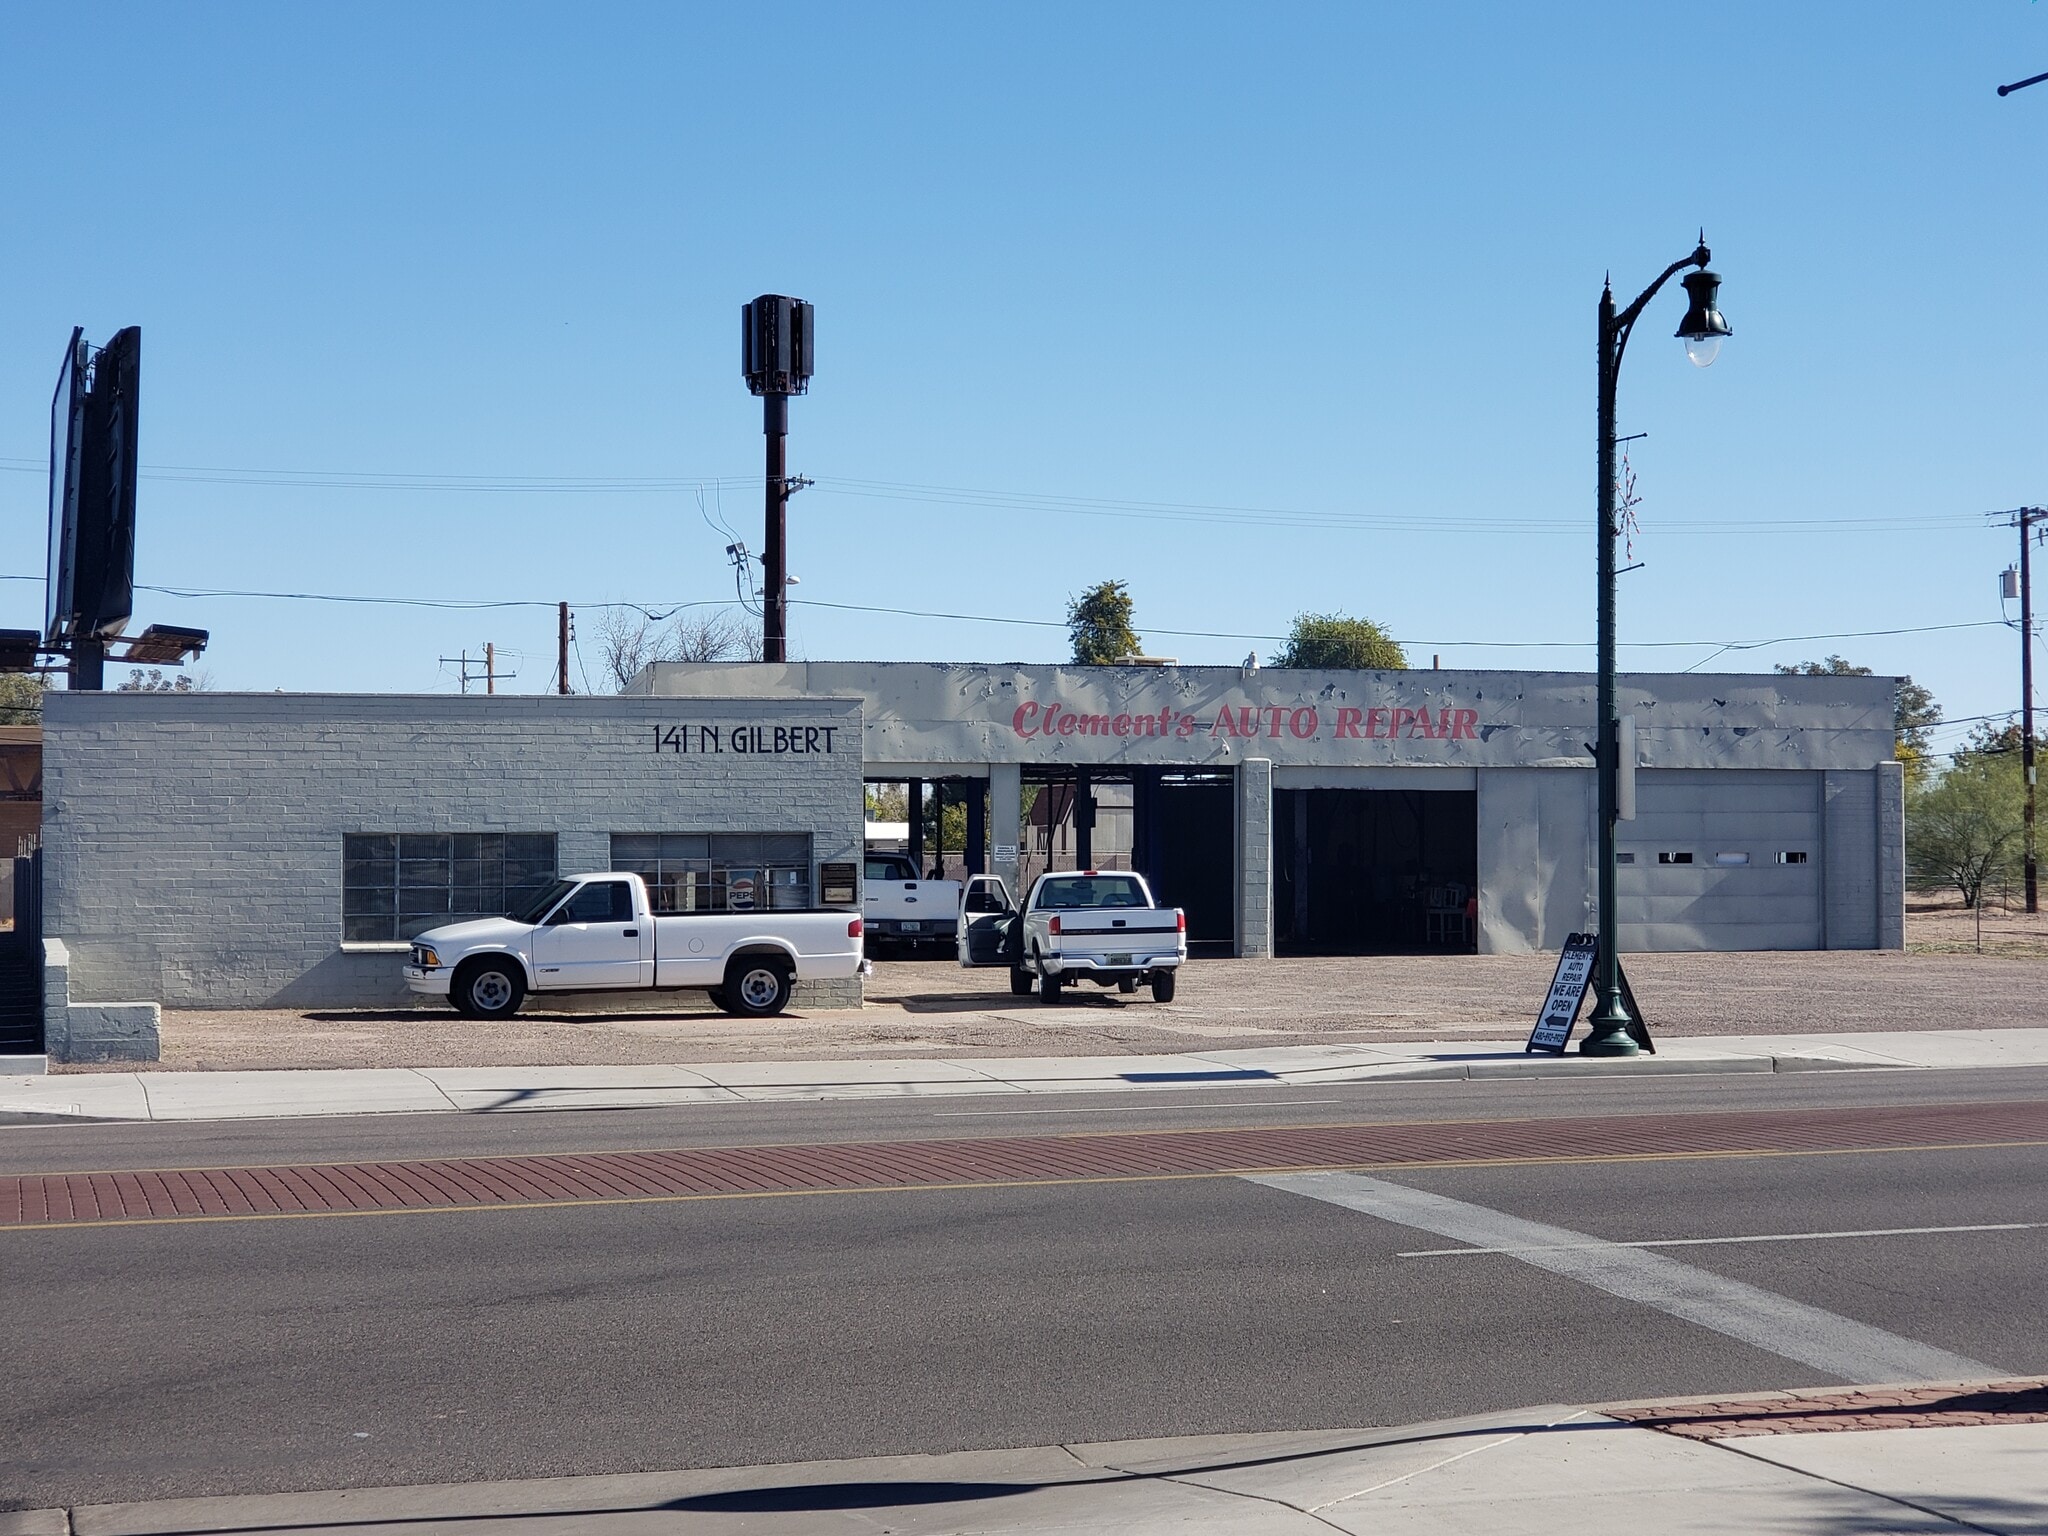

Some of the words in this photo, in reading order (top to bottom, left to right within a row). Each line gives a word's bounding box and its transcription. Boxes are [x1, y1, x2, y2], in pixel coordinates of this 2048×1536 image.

[1012, 701, 1196, 738] Clement's
[1208, 703, 1319, 739] AUTO
[1333, 704, 1479, 740] REPAIR
[653, 725, 688, 753] 141
[701, 726, 723, 753] N.
[731, 726, 838, 753] GILBERT
[729, 891, 755, 899] PEPS
[1564, 950, 1594, 961] CLEMENT'S
[1568, 962, 1583, 971] AUTO
[1562, 973, 1582, 982] REPAIR
[1553, 984, 1566, 996] WE
[1565, 985, 1582, 997] ARE
[1551, 1000, 1572, 1012] OPEN
